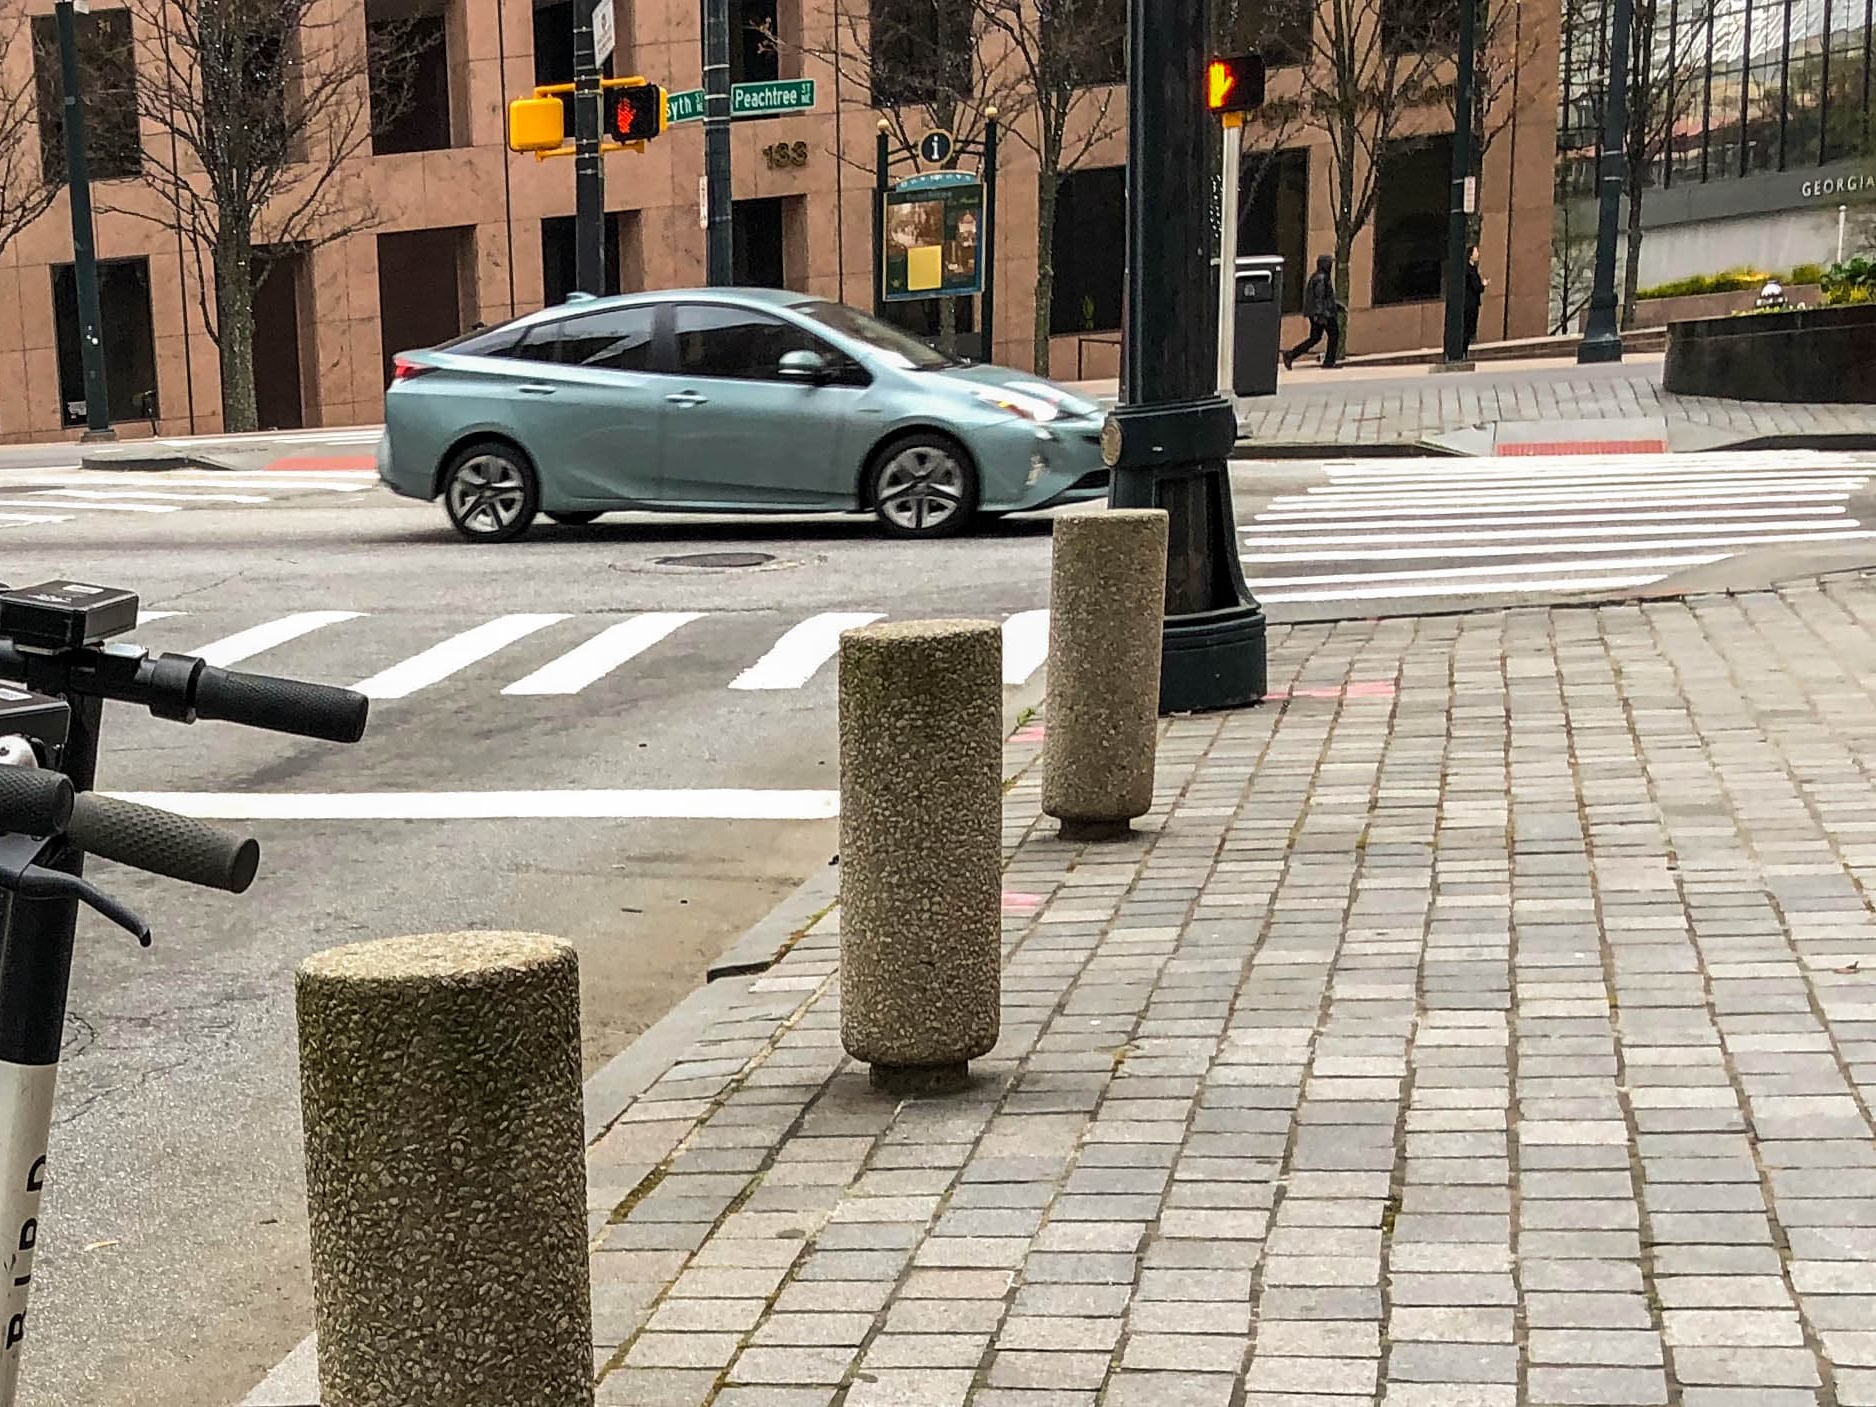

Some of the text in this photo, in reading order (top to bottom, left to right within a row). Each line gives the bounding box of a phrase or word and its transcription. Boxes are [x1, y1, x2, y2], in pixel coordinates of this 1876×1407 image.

[735, 87, 797, 109] Peachtree
[762, 141, 808, 169] 133
[1802, 175, 1875, 197] GEORGIA
